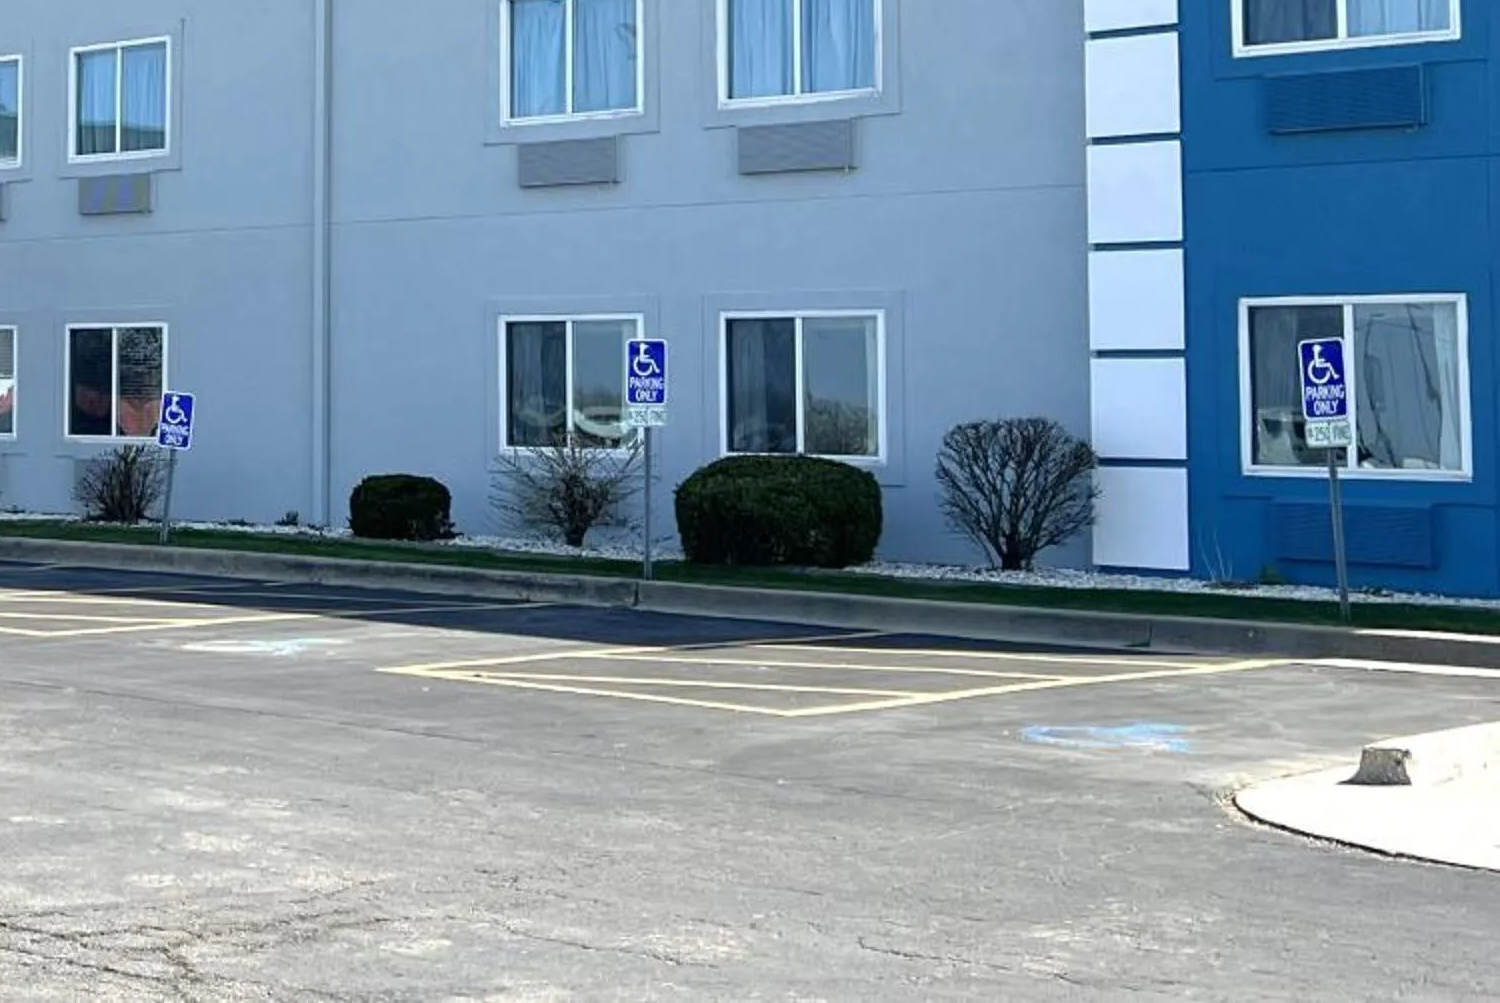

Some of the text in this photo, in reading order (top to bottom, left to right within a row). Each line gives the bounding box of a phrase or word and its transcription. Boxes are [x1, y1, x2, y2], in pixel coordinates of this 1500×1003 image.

[629, 376, 664, 390] PARKING
[635, 388, 659, 402] ONLY
[1305, 384, 1345, 401] PARKING
[1313, 399, 1339, 416] ONLY
